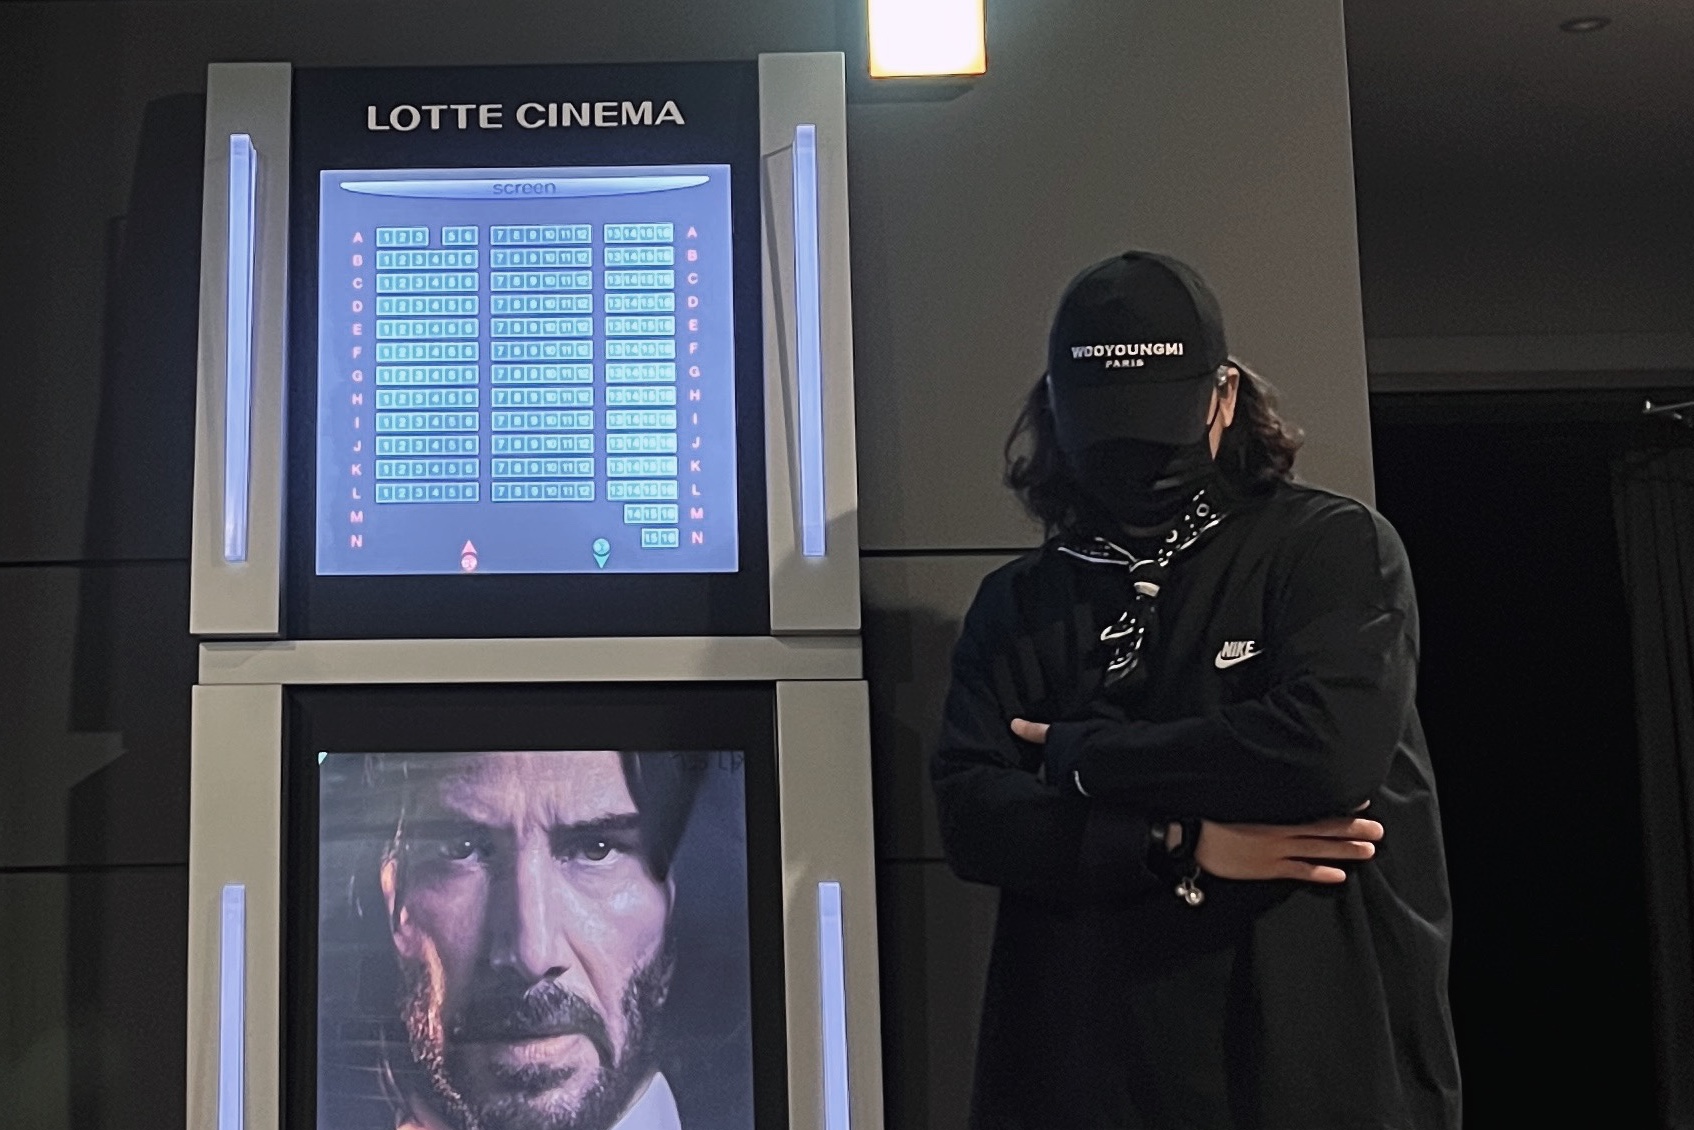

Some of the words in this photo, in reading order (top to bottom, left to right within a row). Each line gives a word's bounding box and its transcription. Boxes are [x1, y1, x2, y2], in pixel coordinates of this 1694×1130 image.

[367, 103, 503, 131] LOTTE
[516, 100, 686, 129] CINEMA
[492, 182, 557, 195] screen
[353, 232, 363, 243] A
[687, 227, 698, 238] A
[352, 254, 363, 267] B
[687, 249, 698, 262] B
[352, 277, 363, 289] C
[687, 272, 698, 285] C
[352, 300, 363, 313] D
[687, 296, 699, 308] D
[352, 323, 362, 336] E
[688, 319, 698, 331] E
[352, 346, 362, 359] F
[689, 342, 698, 354] F
[1071, 342, 1184, 359] WOOYOUNGMI
[1105, 358, 1145, 369] PARIS
[352, 370, 363, 383] G
[689, 366, 701, 378] G
[352, 393, 363, 405] H
[689, 389, 701, 401] H
[354, 416, 360, 429] I
[692, 413, 698, 425] I
[353, 440, 362, 452] J
[692, 436, 700, 449] J
[351, 464, 362, 476] K
[690, 460, 701, 472] K
[352, 487, 361, 499] L
[691, 484, 701, 496] L
[350, 511, 363, 523] M
[690, 507, 704, 519] M
[350, 535, 363, 548] N
[691, 531, 703, 544] N
[1221, 640, 1256, 658] NIKE
